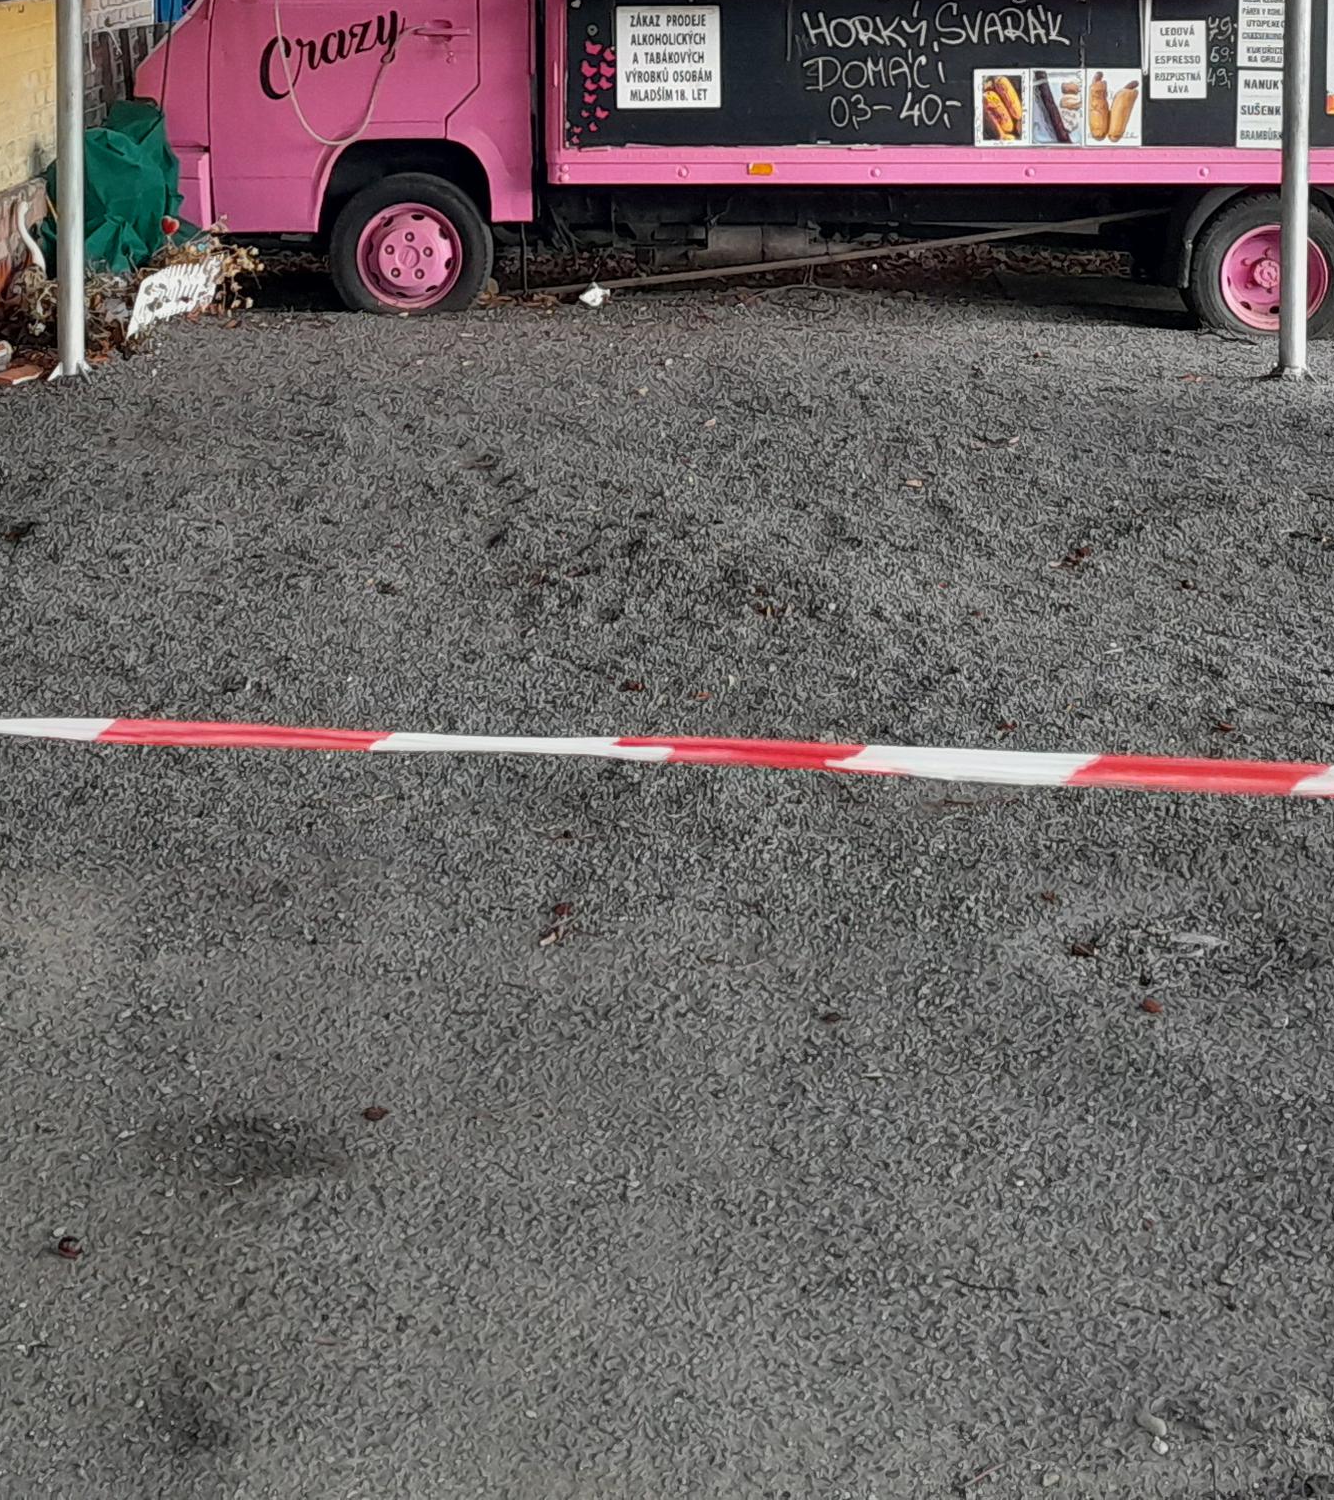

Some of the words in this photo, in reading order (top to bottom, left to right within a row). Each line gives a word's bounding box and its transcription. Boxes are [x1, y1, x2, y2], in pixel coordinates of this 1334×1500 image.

[1268, 6, 1283, 16] ROHLÍ
[630, 12, 661, 28] ZÁKAZ
[666, 14, 707, 28] PRODEJE
[1160, 25, 1196, 36] LEDOVÁ
[630, 31, 706, 46] ALKOHOLICKÝCH
[1165, 37, 1190, 47] KÁVA
[259, 10, 407, 100] Crazy
[632, 52, 639, 64] A
[644, 48, 705, 64] TABÁKOVÝCH
[1155, 55, 1201, 65] ESPRESSO
[625, 67, 669, 83] VÝROBKŮ
[673, 67, 713, 83] OSOBÁM
[1155, 70, 1202, 82] ROZPUSTNÁ
[630, 86, 674, 102] MLADŠÍM
[675, 88, 689, 101] 18.
[692, 88, 708, 101] LET
[1167, 82, 1190, 94] KÁVA
[1240, 103, 1282, 116] SUŠENK
